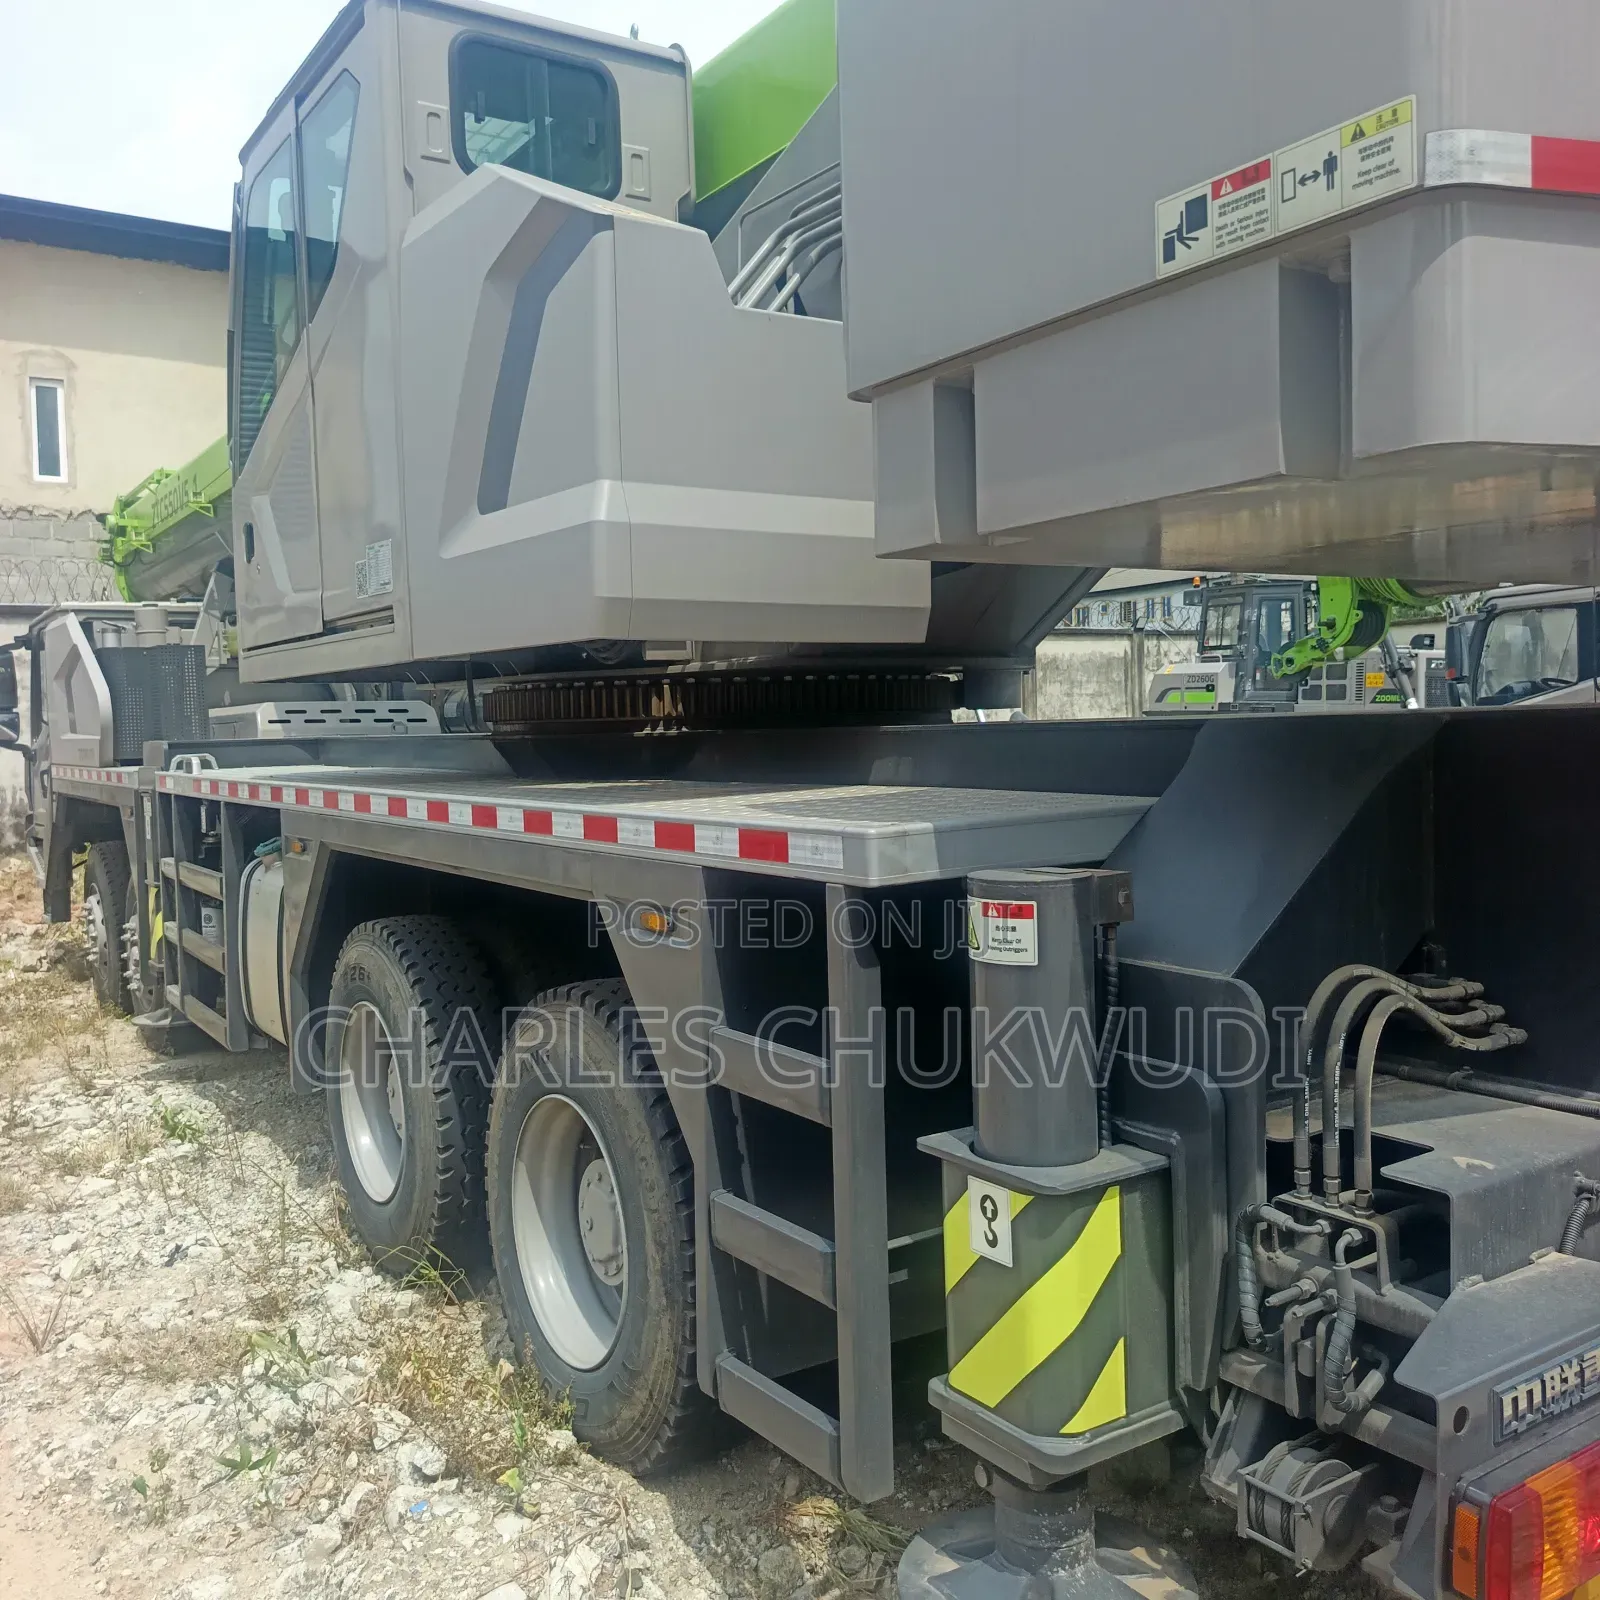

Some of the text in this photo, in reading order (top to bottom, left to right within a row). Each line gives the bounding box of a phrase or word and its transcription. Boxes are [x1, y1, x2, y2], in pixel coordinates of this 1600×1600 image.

[1357, 158, 1395, 179] Keep clear of
[1352, 168, 1401, 190] moving machine.
[1215, 223, 1229, 233] Death
[1225, 227, 1238, 238] result
[1239, 223, 1251, 232] from
[1252, 216, 1270, 227] contact
[1215, 241, 1226, 249] with
[1227, 234, 1245, 244] moving
[1187, 674, 1215, 683] ZD260G
[1375, 694, 1404, 702] ZOOML
